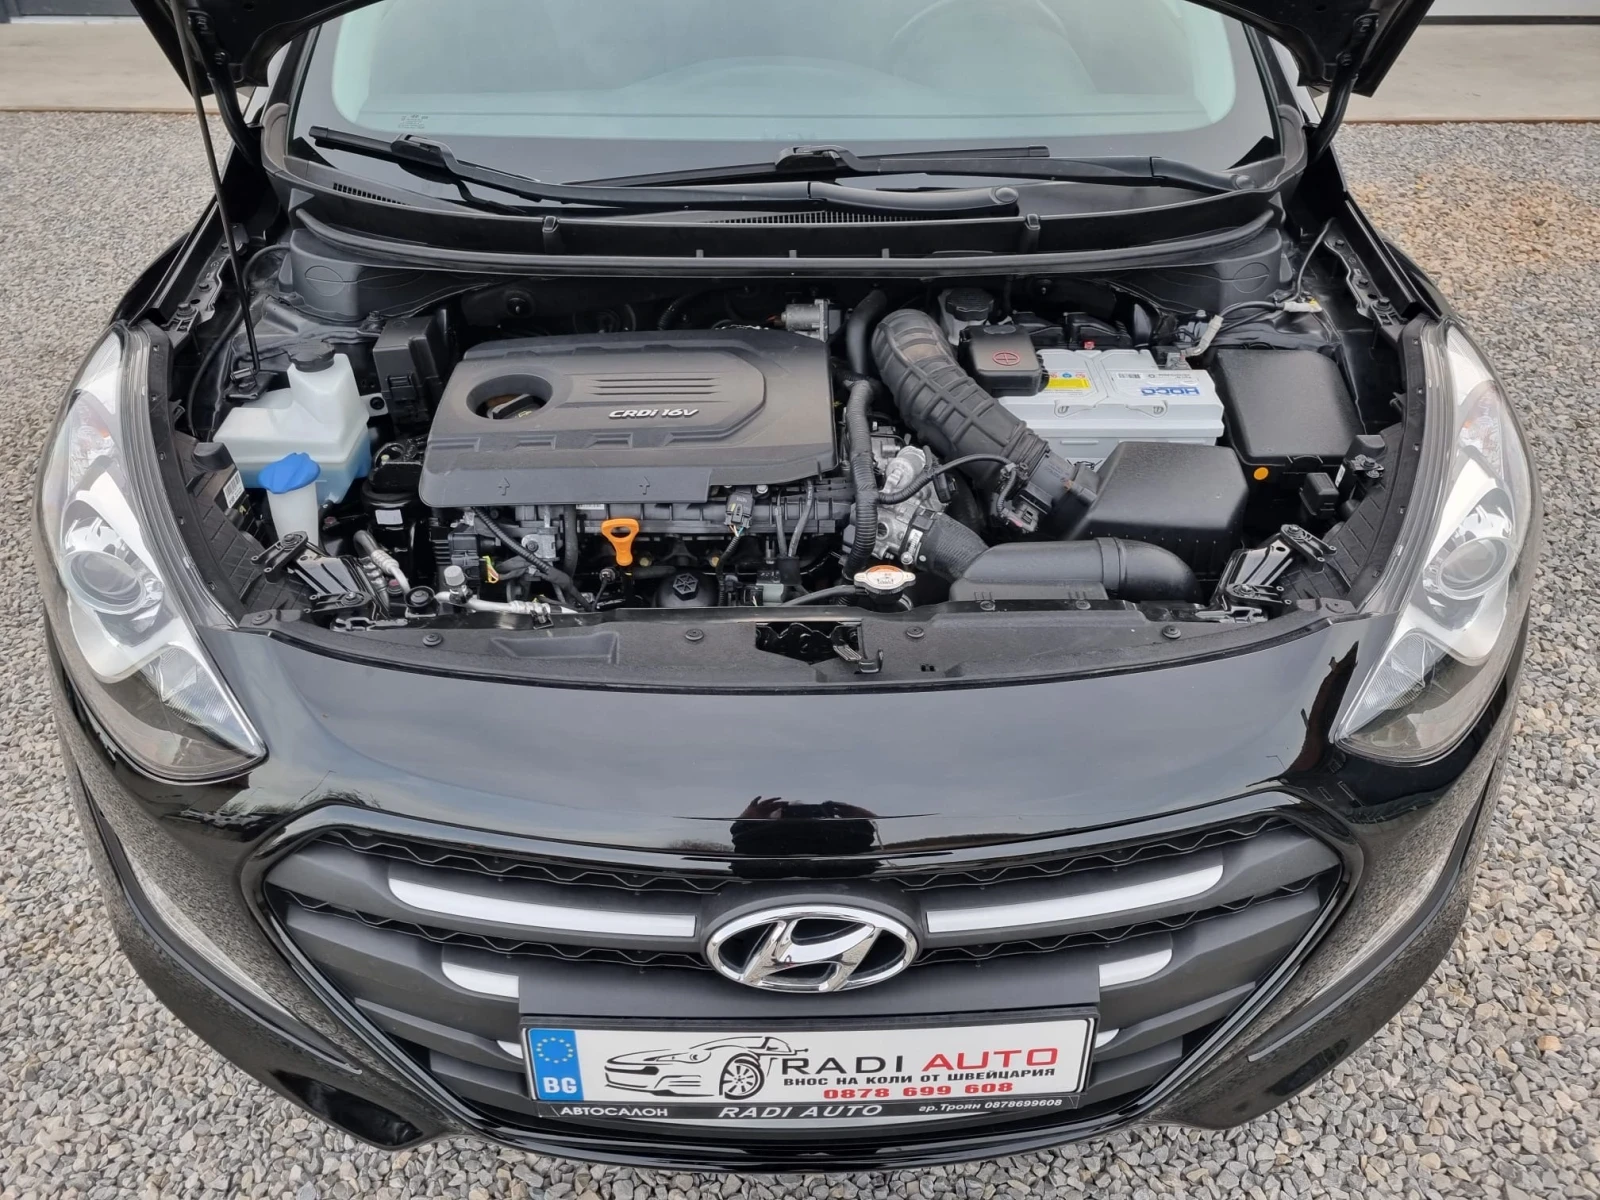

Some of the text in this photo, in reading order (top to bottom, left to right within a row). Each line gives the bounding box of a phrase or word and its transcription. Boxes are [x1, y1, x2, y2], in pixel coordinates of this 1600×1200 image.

[661, 408, 700, 418] 16V
[781, 1047, 1059, 1075] RADI AUTO
[543, 1076, 578, 1094] BG
[783, 1068, 1056, 1086] ВНОС НА КОЛИ ОТ ШВЕЙЦАРИЯ
[823, 1082, 1013, 1099] 0878 699 608
[559, 1105, 669, 1118] АВТОСАЛОН
[718, 1104, 884, 1119] RADI AUTO
[984, 1098, 1063, 1110] 0878699608
